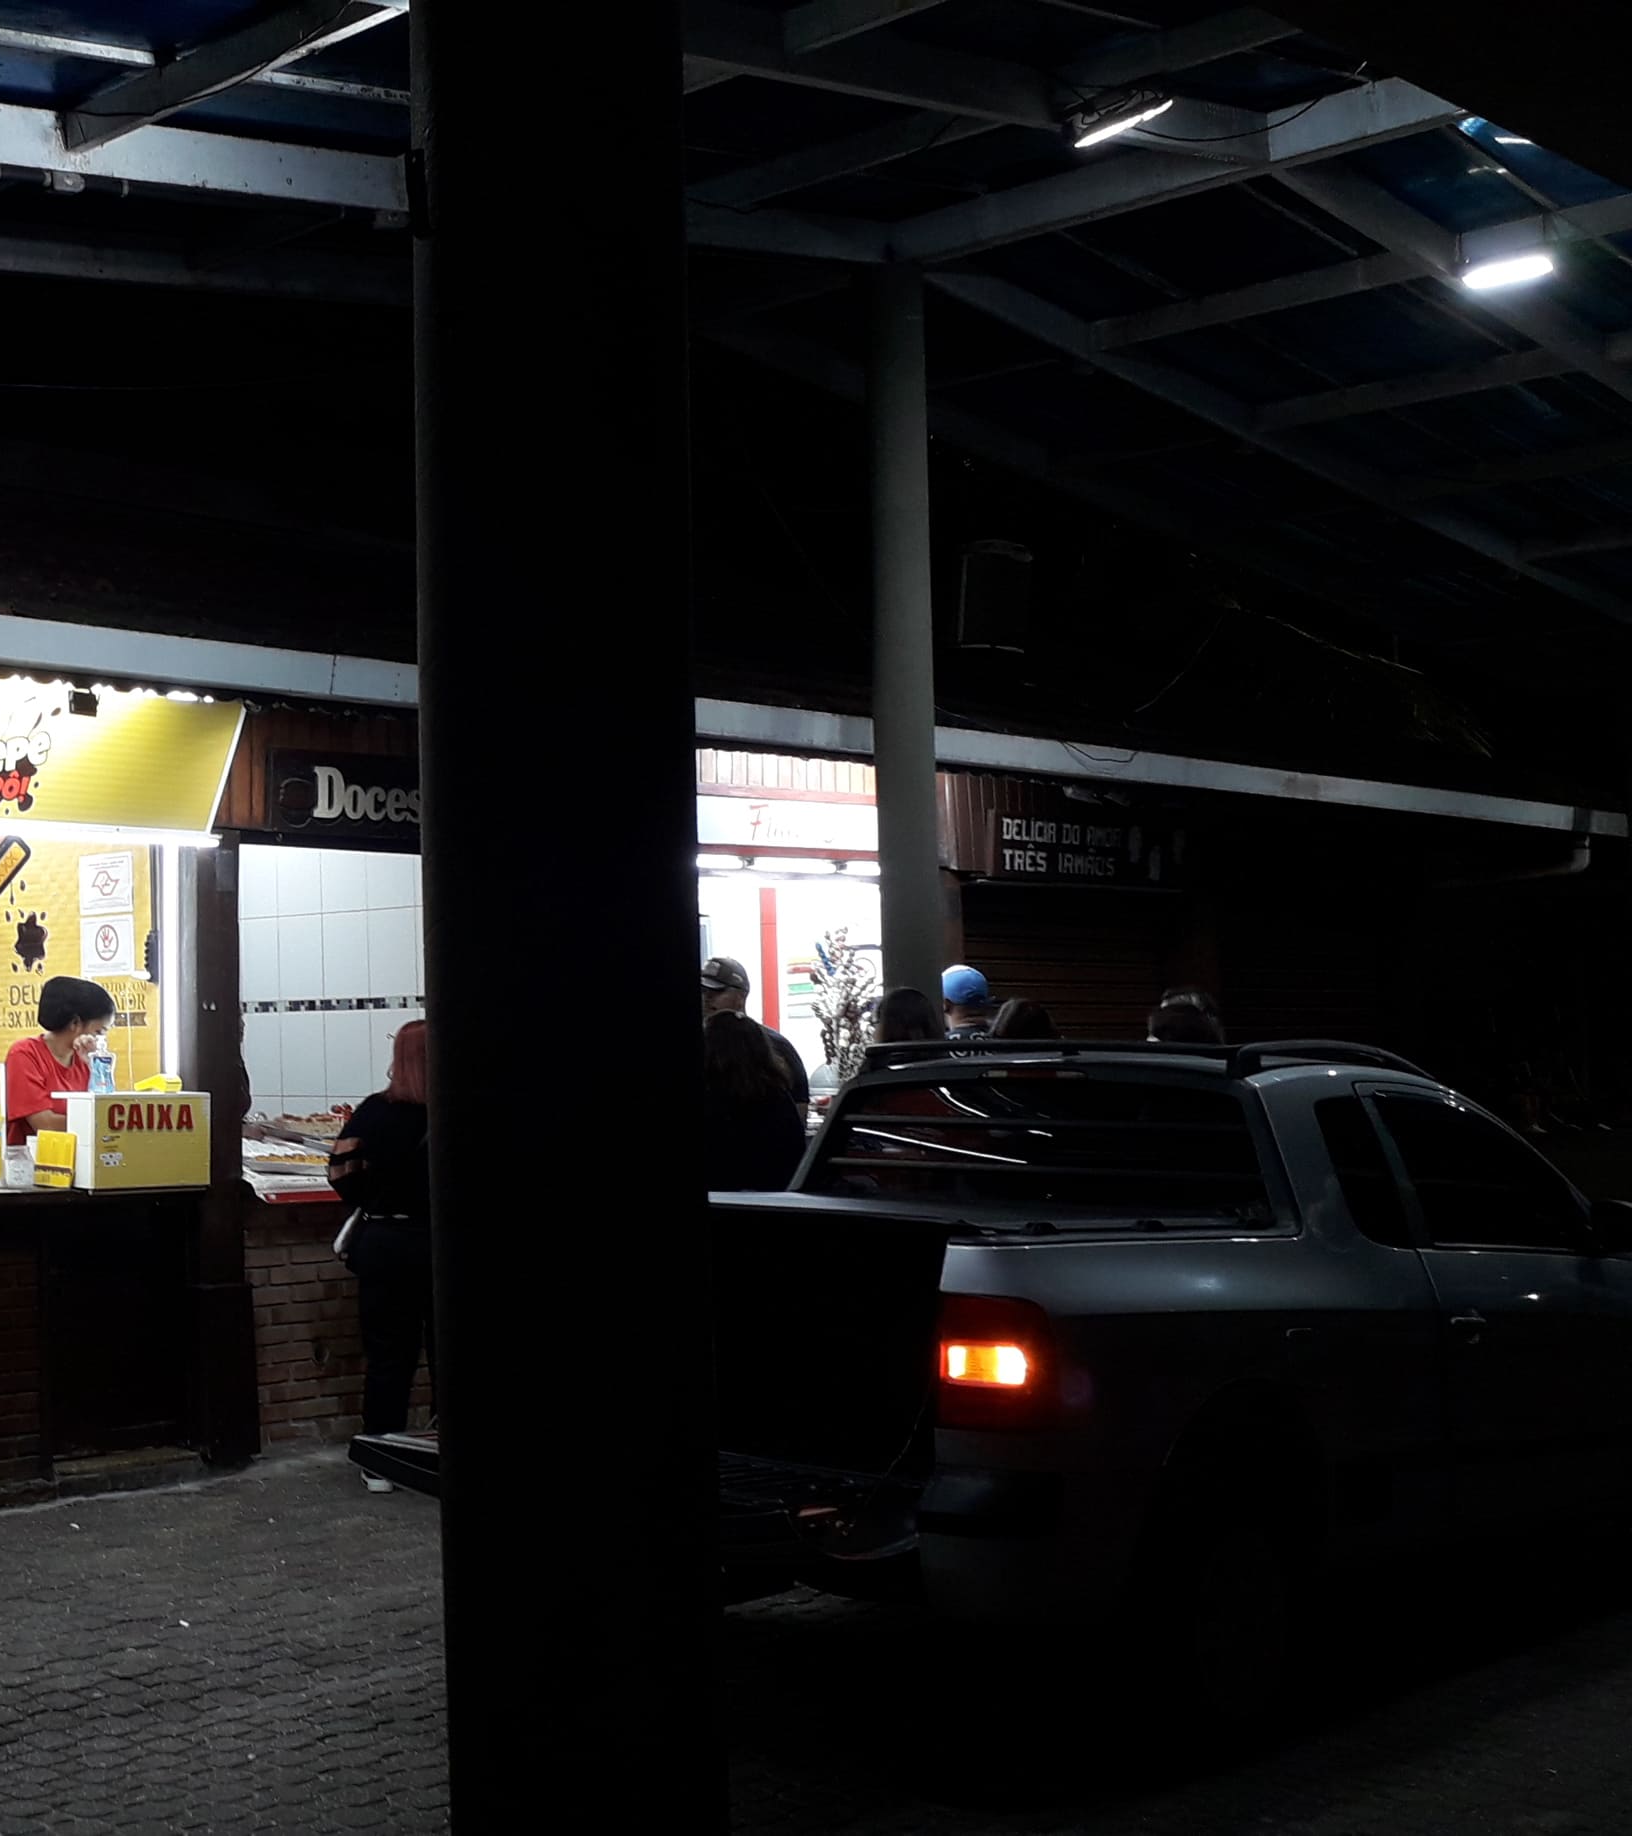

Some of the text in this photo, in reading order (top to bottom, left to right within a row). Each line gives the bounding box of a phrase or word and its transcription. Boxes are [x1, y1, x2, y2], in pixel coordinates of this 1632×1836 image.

[313, 765, 422, 824] Doces
[1002, 816, 1057, 844] DELÍCIA
[1061, 824, 1081, 846] DO
[1003, 843, 1117, 876] TRÊS IRMÃOS
[8, 1010, 23, 1029] 3X
[107, 1102, 195, 1132] CAIXA
